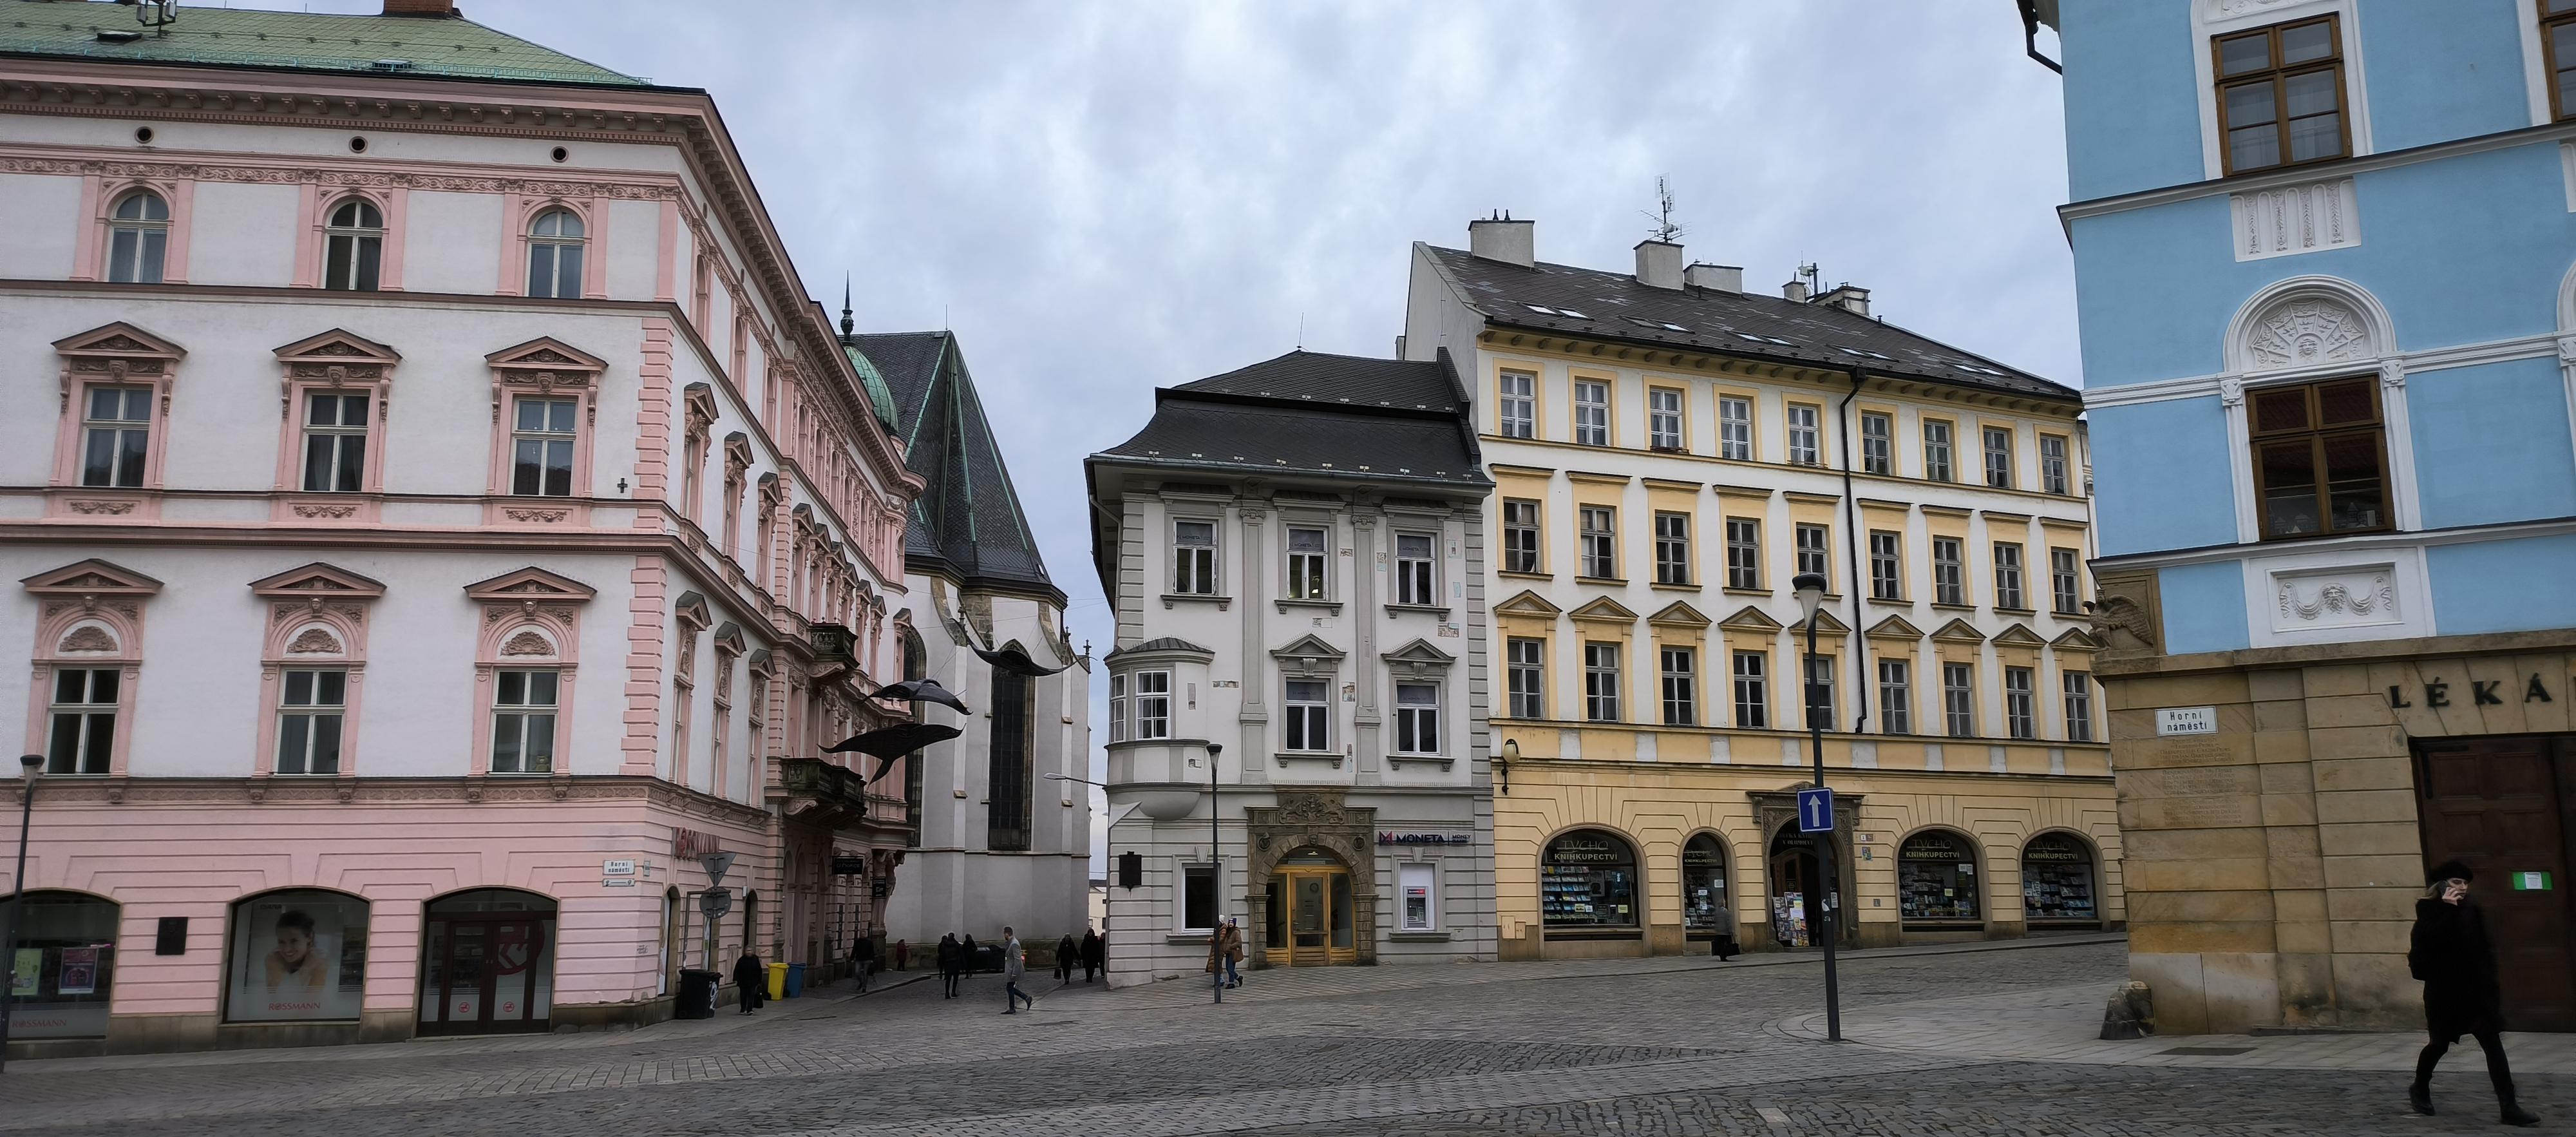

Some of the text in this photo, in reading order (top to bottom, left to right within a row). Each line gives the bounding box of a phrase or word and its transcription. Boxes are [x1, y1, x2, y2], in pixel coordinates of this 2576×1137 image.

[2389, 672, 2576, 709] LÉKÁ
[2170, 711, 2202, 721] Horní
[2167, 721, 2208, 732] náměstí
[1396, 834, 1444, 843] MONETA
[1555, 852, 1618, 860] KNIHKUPECTVÍ
[2028, 852, 2078, 860] KNIHKUPECTVÍ
[269, 1002, 321, 1011] ROSSMANN
[12, 1019, 67, 1028] ROSSMANN
